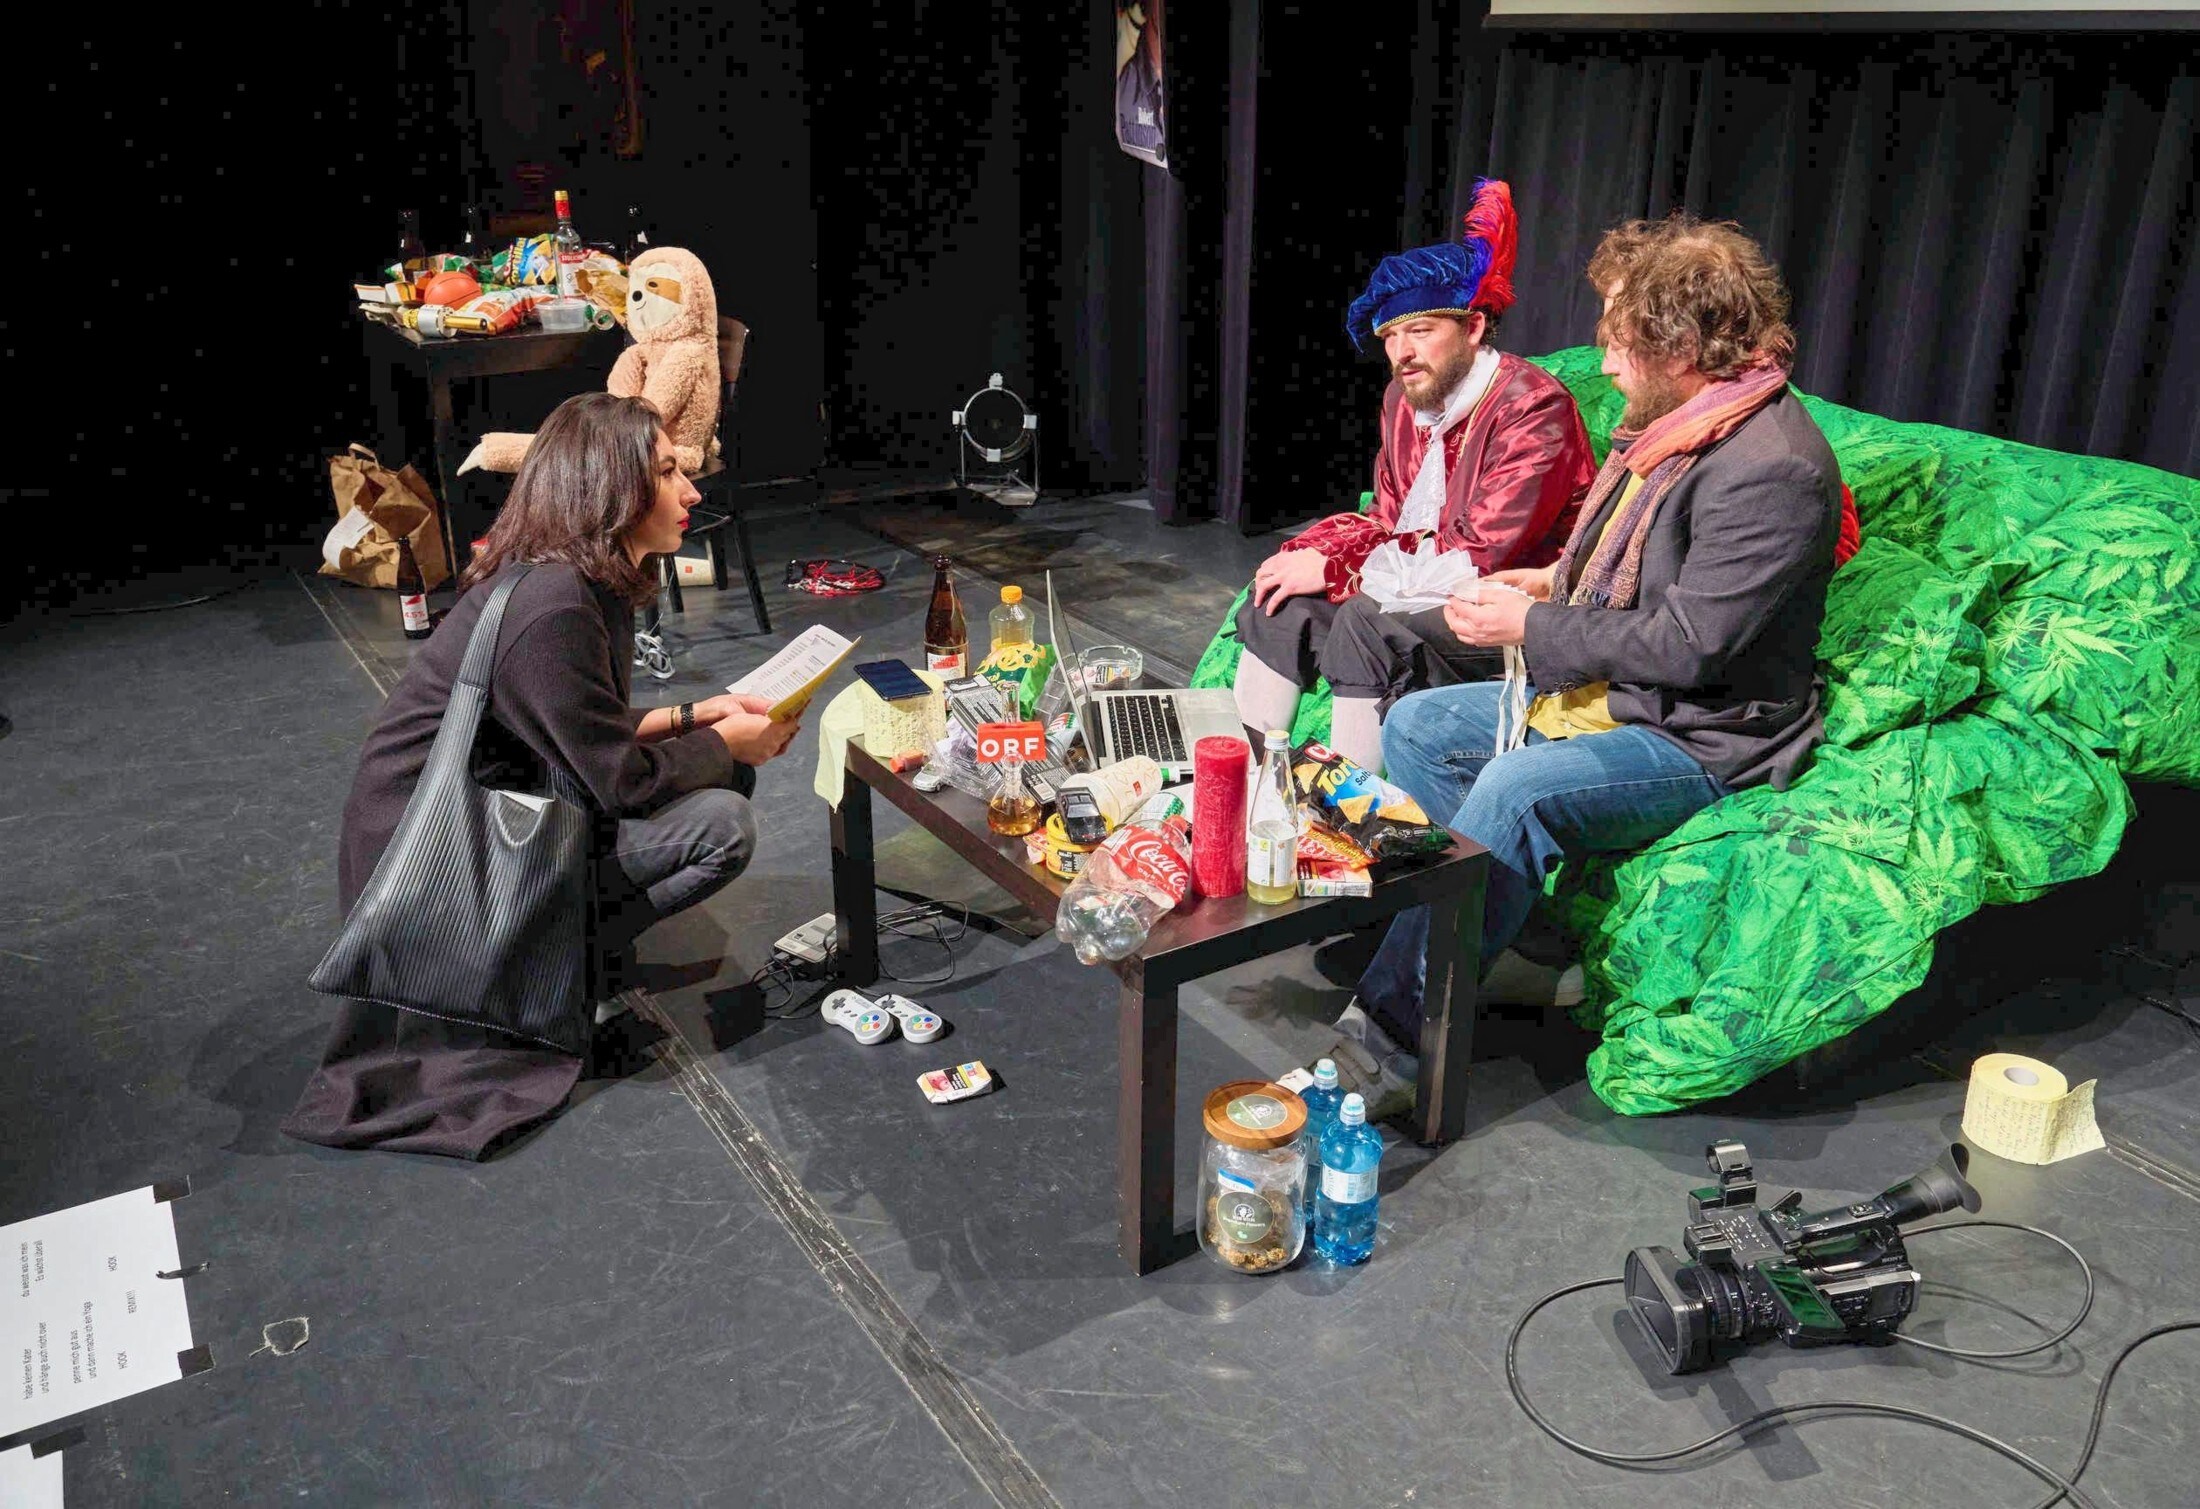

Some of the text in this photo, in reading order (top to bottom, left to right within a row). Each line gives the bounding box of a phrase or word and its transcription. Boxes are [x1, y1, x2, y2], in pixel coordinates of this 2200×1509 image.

[981, 737, 1040, 758] ORF
[107, 1255, 118, 1272] HOOK
[1881, 1255, 1904, 1263] SONY
[117, 1350, 128, 1370] HOOK
[87, 1366, 97, 1379] und
[40, 1382, 49, 1394] und
